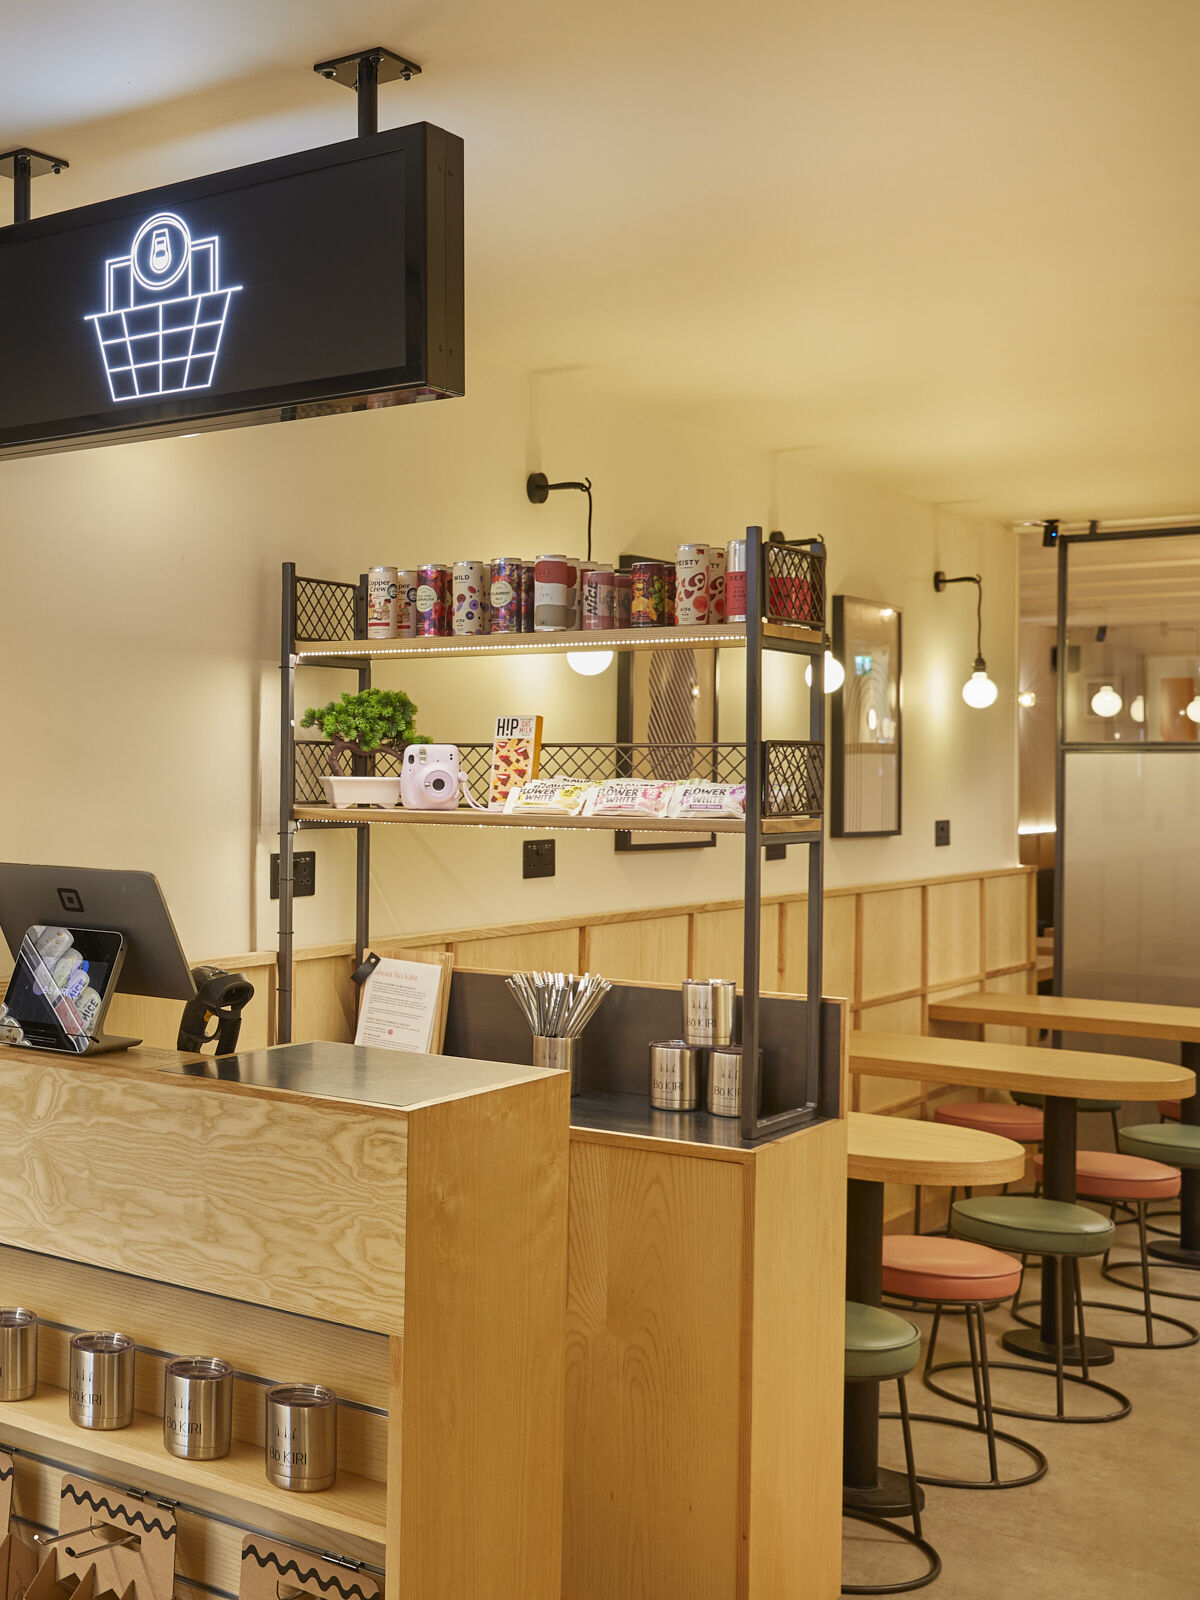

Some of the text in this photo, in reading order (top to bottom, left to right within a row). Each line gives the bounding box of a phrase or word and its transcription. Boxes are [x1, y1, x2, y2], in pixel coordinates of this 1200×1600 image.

[683, 788, 727, 797] FLOWER
[605, 796, 637, 804] WHITE
[698, 1018, 717, 1029] KIRI
[665, 1081, 683, 1092] KIRI
[82, 1392, 101, 1406] KIRI
[179, 1420, 202, 1435] KIRI
[283, 1450, 307, 1465] KIRI
